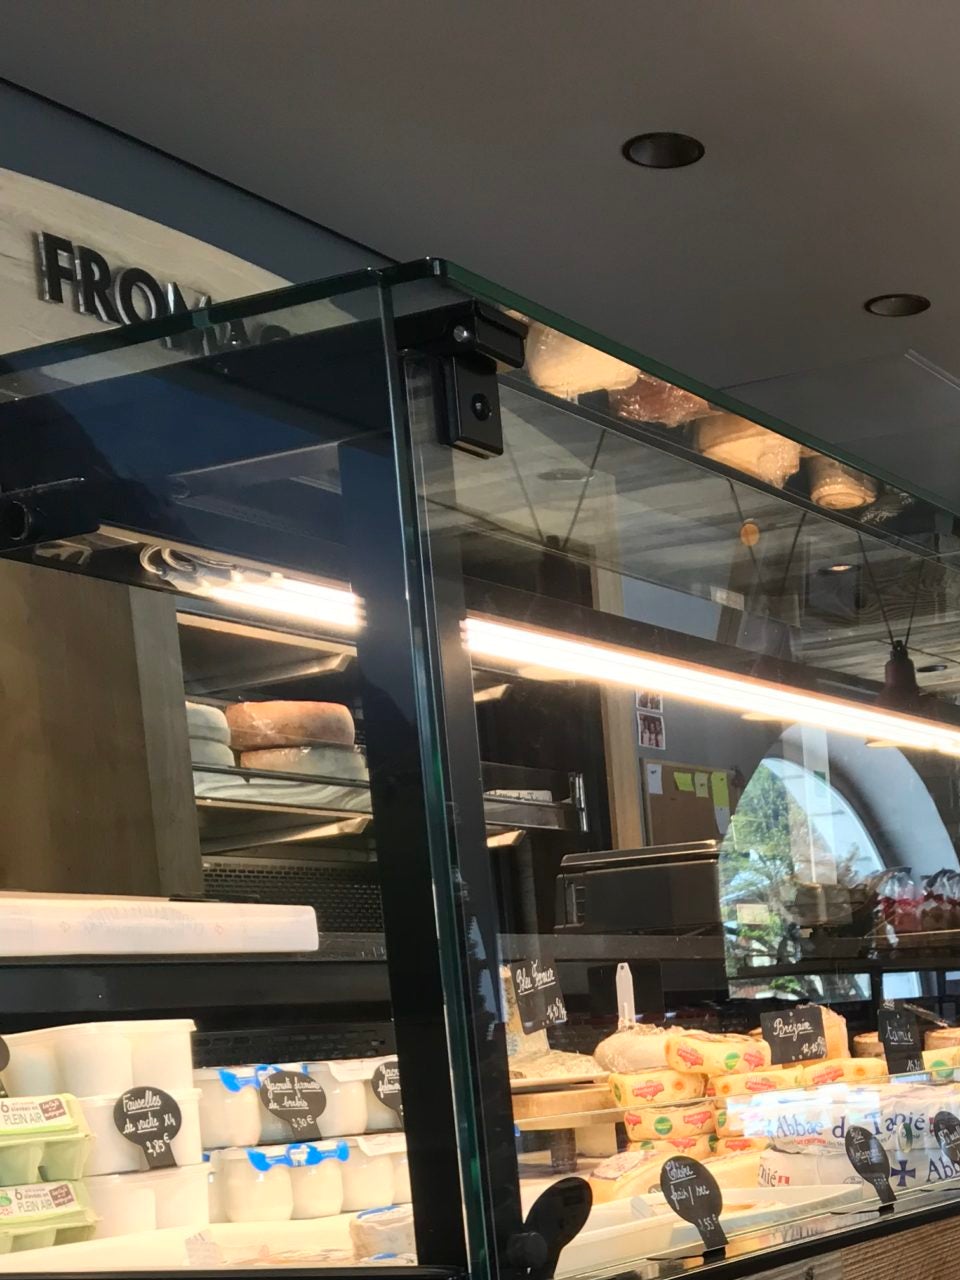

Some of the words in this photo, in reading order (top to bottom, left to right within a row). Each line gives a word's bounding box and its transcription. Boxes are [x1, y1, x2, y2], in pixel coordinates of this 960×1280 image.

[122, 1089, 162, 1113] Faisselles
[3, 1112, 28, 1125] PLEIN
[29, 1111, 44, 1123] AIR
[122, 1118, 136, 1135] de
[136, 1111, 159, 1133] vache
[832, 1115, 846, 1139] d
[17, 1200, 40, 1213] PLEIN
[40, 1198, 55, 1210] AIR
